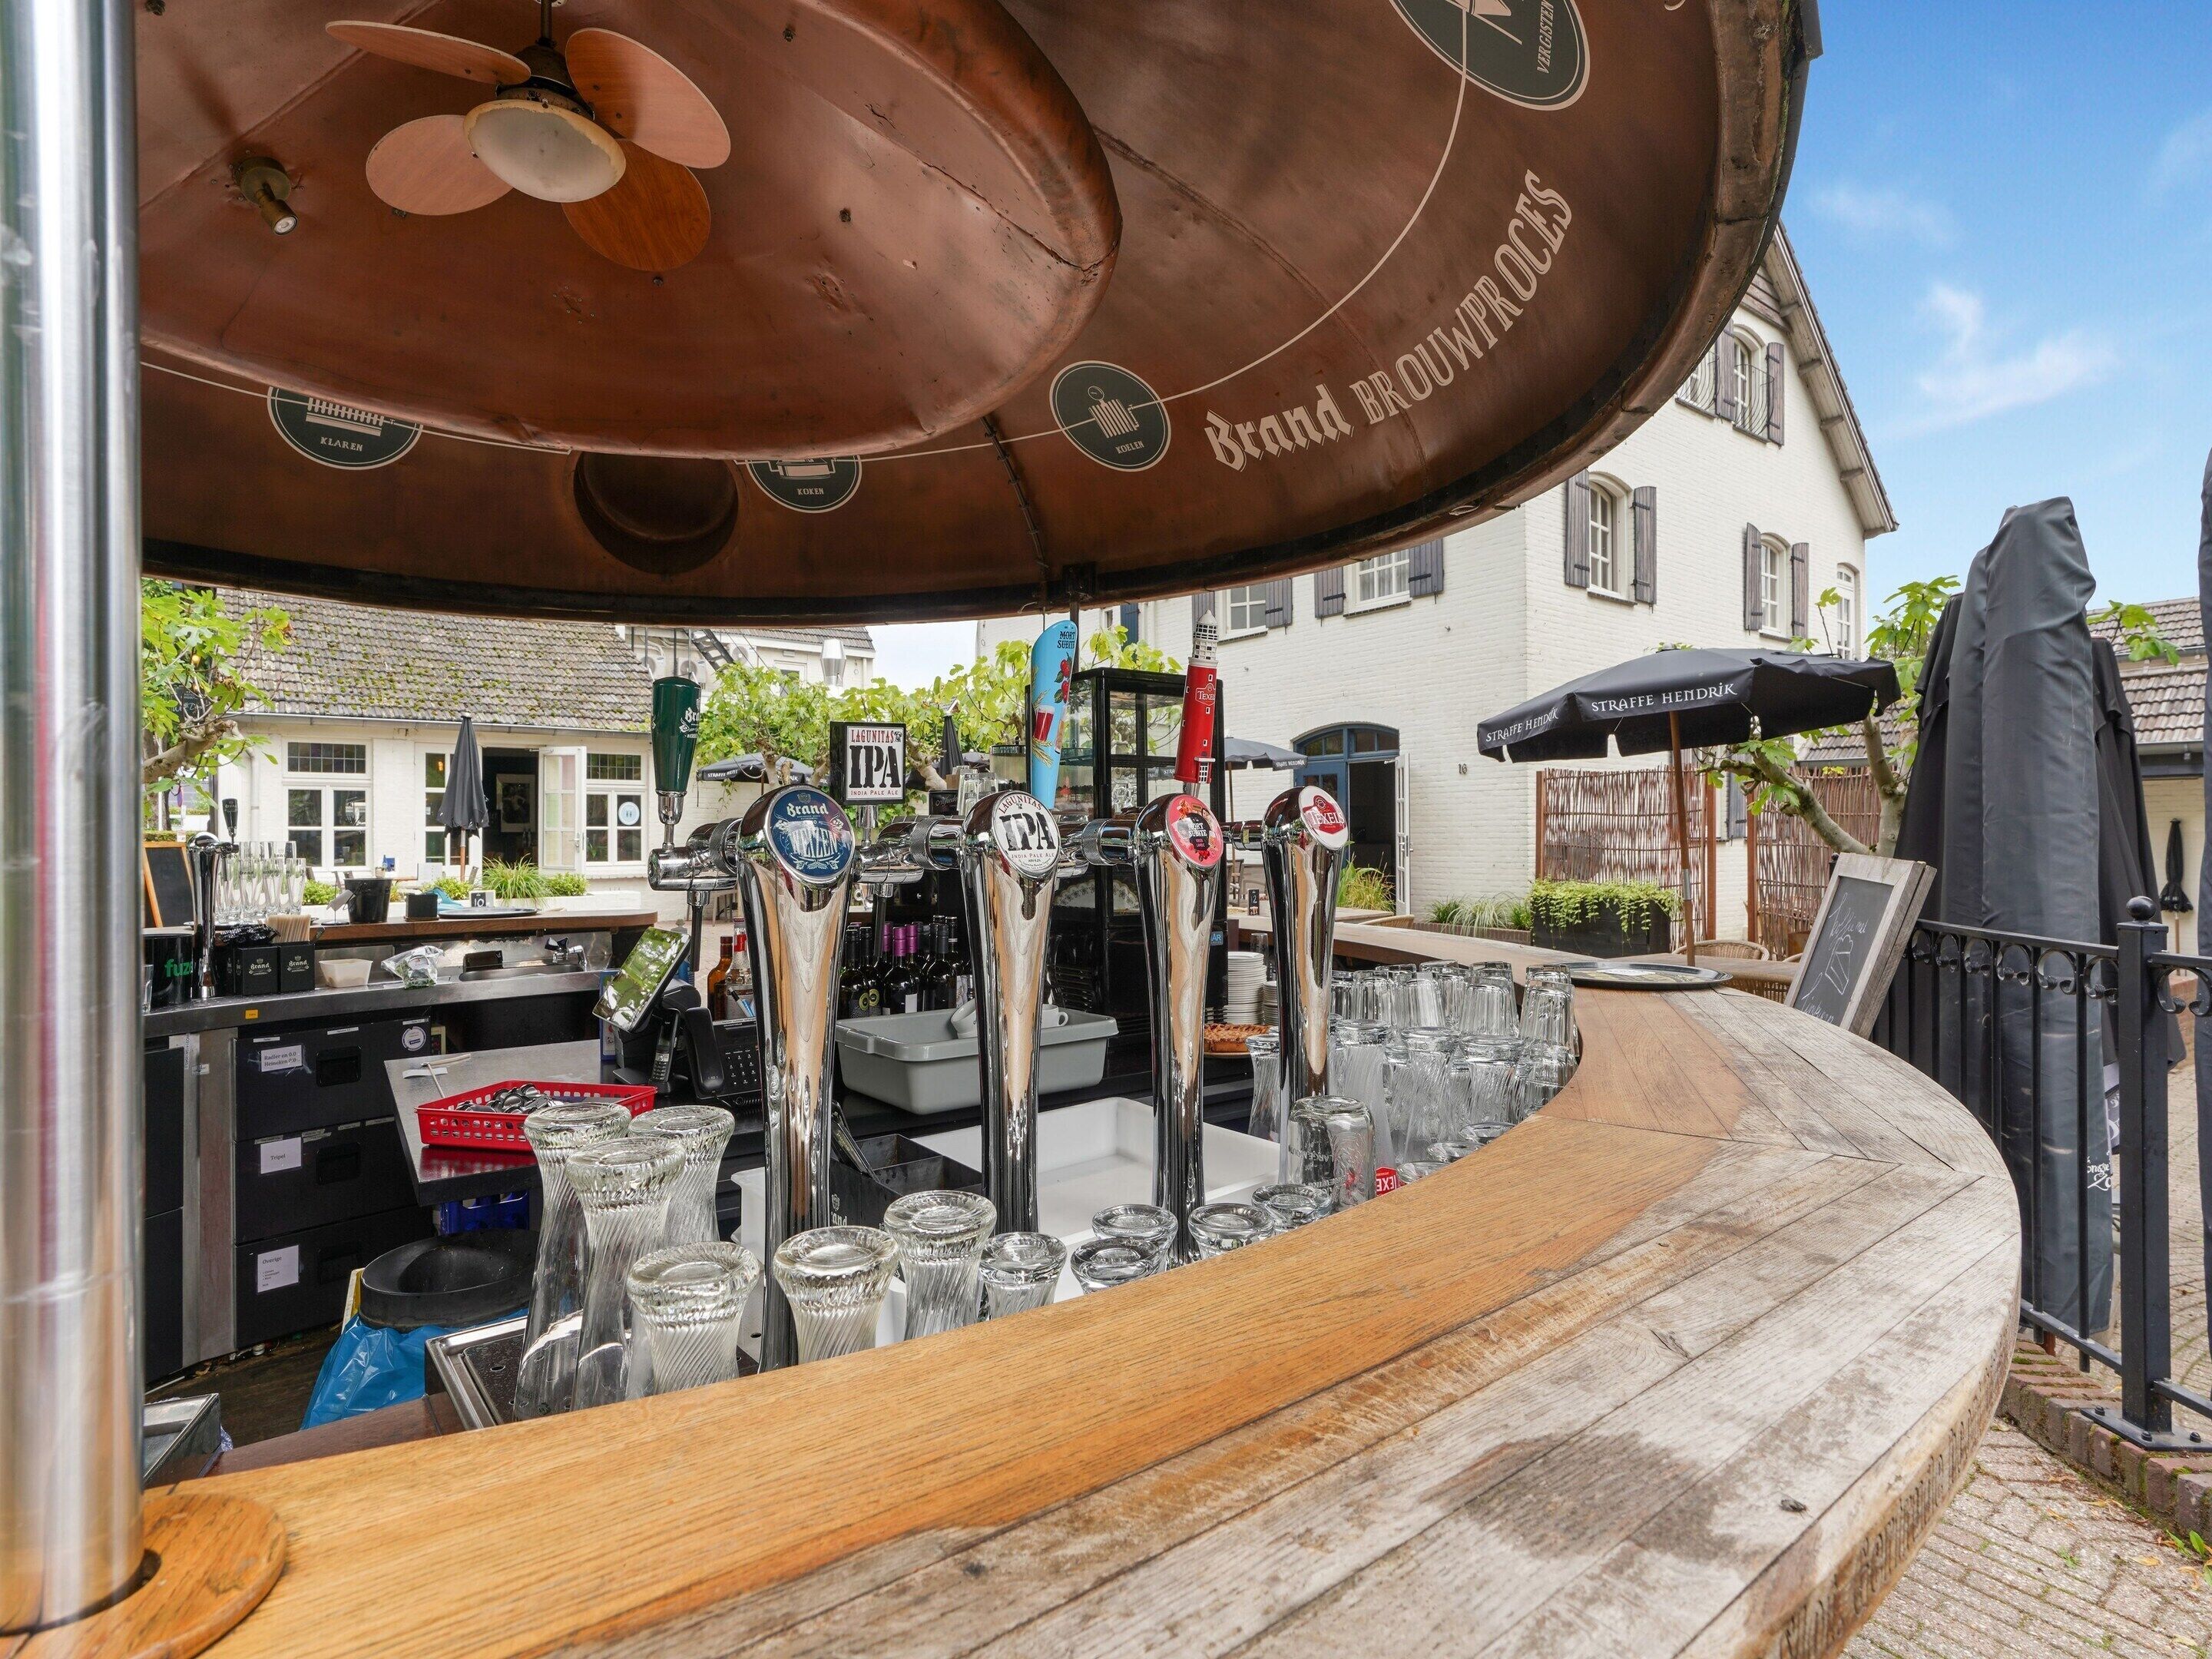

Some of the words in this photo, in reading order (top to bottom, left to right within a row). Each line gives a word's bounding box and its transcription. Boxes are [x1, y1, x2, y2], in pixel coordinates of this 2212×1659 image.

[1204, 383, 1355, 472] Brand
[1349, 169, 1573, 425] BROUWPROCES
[320, 436, 363, 452] KLAREN
[1115, 440, 1145, 455] KOELEN
[1591, 694, 1654, 712] STRAFFE
[1662, 682, 1738, 704] HENDRIK
[684, 707, 700, 723] Bra
[851, 730, 894, 743] LAGUNITAS
[1485, 723, 1523, 742] STRAFFE
[849, 745, 902, 789] IPA
[1458, 763, 1468, 774] 16
[786, 803, 829, 817] Brand
[998, 795, 1042, 814] LAGUNITAS
[1304, 810, 1346, 829] TEXELS
[999, 812, 1057, 851] IPA
[474, 898, 485, 907] 10
[2088, 1173, 2112, 1191] Zo
[831, 1211, 848, 1226] and
[262, 1257, 283, 1265] Overige
